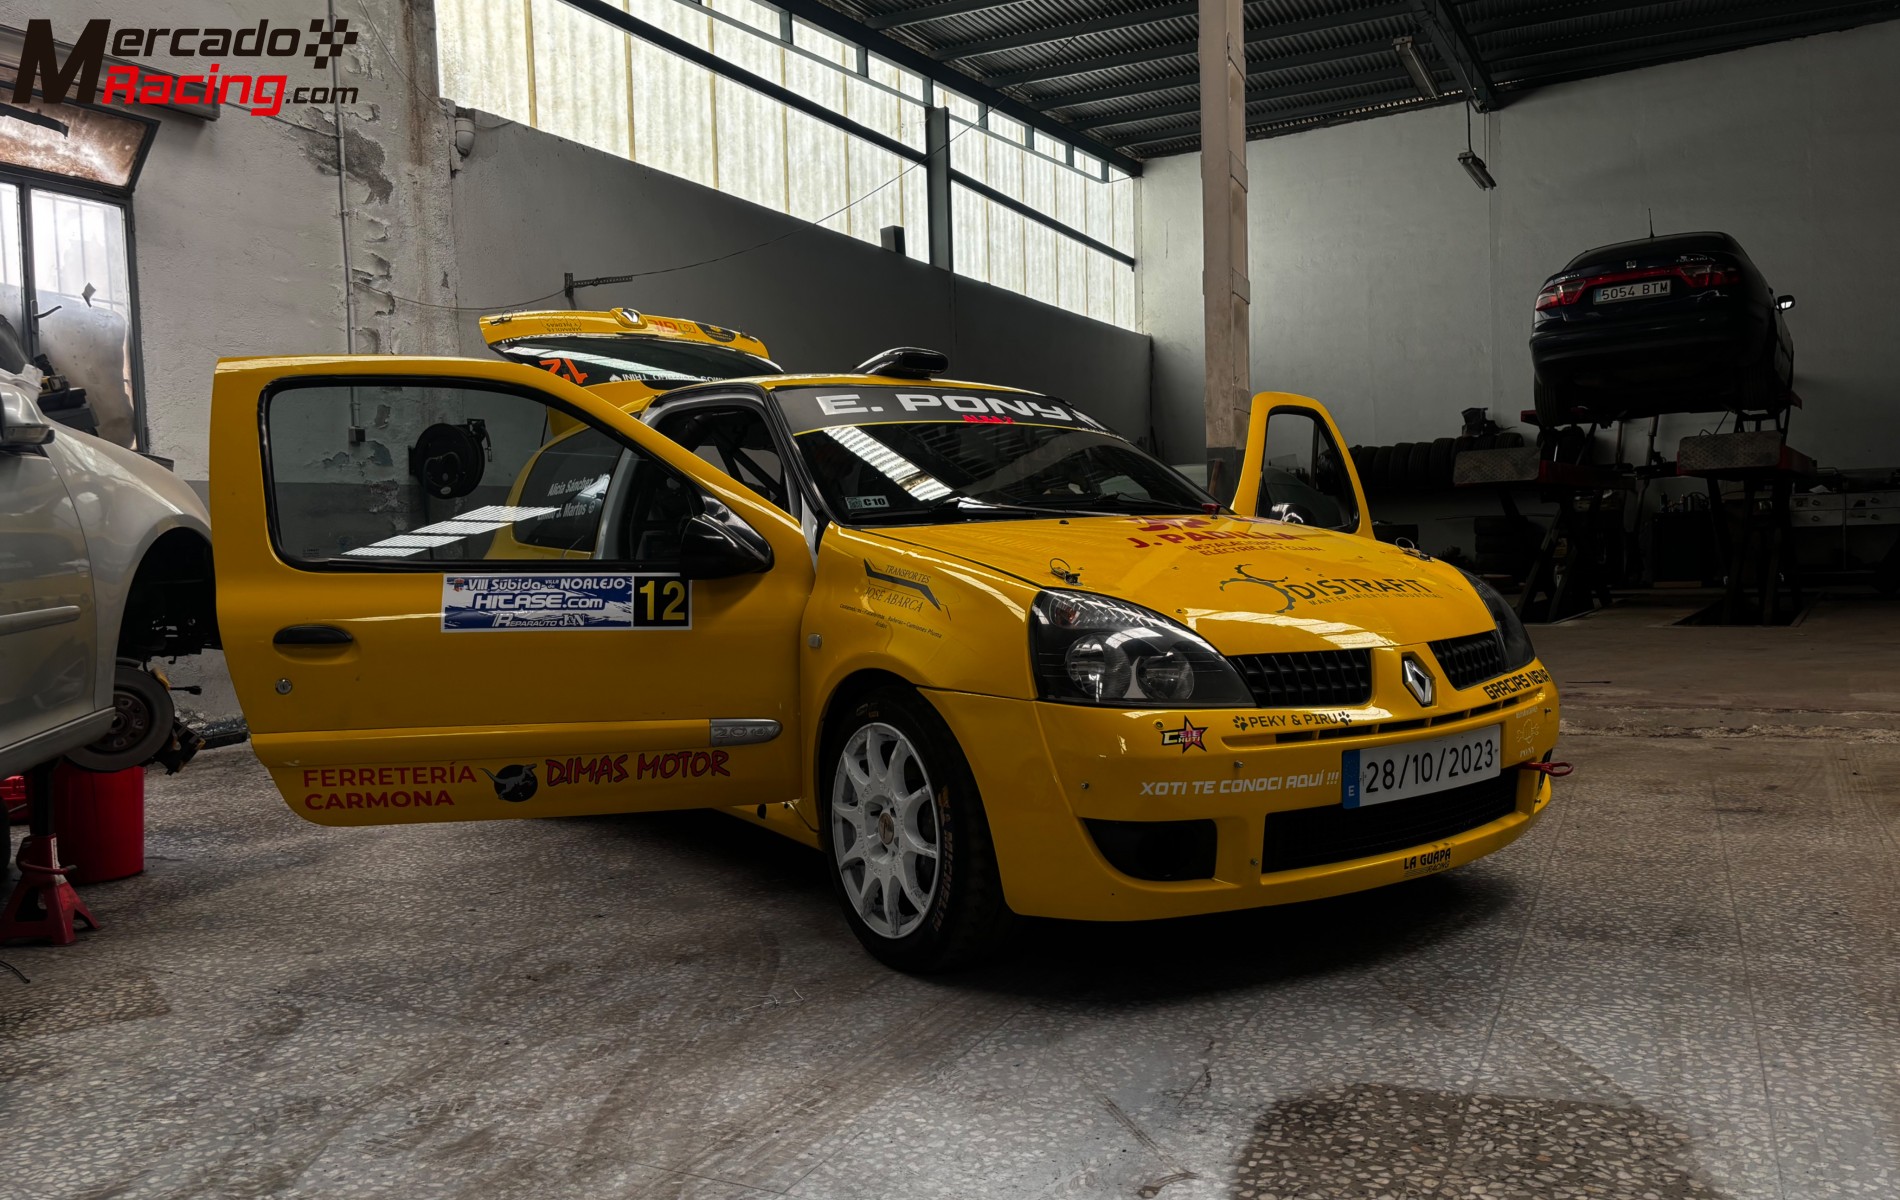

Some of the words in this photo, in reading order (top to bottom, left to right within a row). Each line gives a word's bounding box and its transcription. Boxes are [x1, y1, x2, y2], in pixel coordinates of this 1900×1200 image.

[1601, 287, 1635, 300] 5054
[1642, 281, 1668, 295] BTM
[816, 394, 884, 416] E.
[895, 394, 1072, 421] PONY
[547, 481, 566, 497] Alicia
[565, 477, 594, 493] Sánchez
[563, 502, 587, 517] Martos
[863, 498, 886, 507] C10
[1163, 530, 1308, 544] PADILLA
[467, 578, 489, 591] VIII
[560, 577, 626, 590] NOALEJO
[885, 564, 931, 584] TRANSPORTES
[1285, 578, 1432, 600] DISTRAFIT
[1308, 592, 1390, 606] MANTENIMIENTO
[1393, 592, 1444, 600] INDUSTRIAL
[639, 579, 688, 622] 12
[865, 586, 886, 601] JOSÉ
[883, 594, 924, 613] ABARCA
[906, 621, 927, 633] Camiones
[927, 628, 943, 639] Pluma
[1483, 671, 1531, 700] GRACIAS
[1248, 715, 1287, 728] PEKY
[1291, 715, 1303, 726] &
[1304, 713, 1339, 725] PIRU
[303, 761, 477, 788] FERRETERÍA
[545, 754, 630, 787] DIMAS
[635, 749, 731, 781] MOTOR
[1366, 739, 1494, 794] 28/10/2023
[1139, 782, 1187, 796] XOTI
[1191, 780, 1219, 794] TE
[1219, 777, 1282, 793] CONOCI
[1347, 785, 1355, 797] E
[304, 789, 455, 811] CARMONA
[1404, 856, 1417, 869] LA
[1420, 847, 1451, 865] GUAPA
